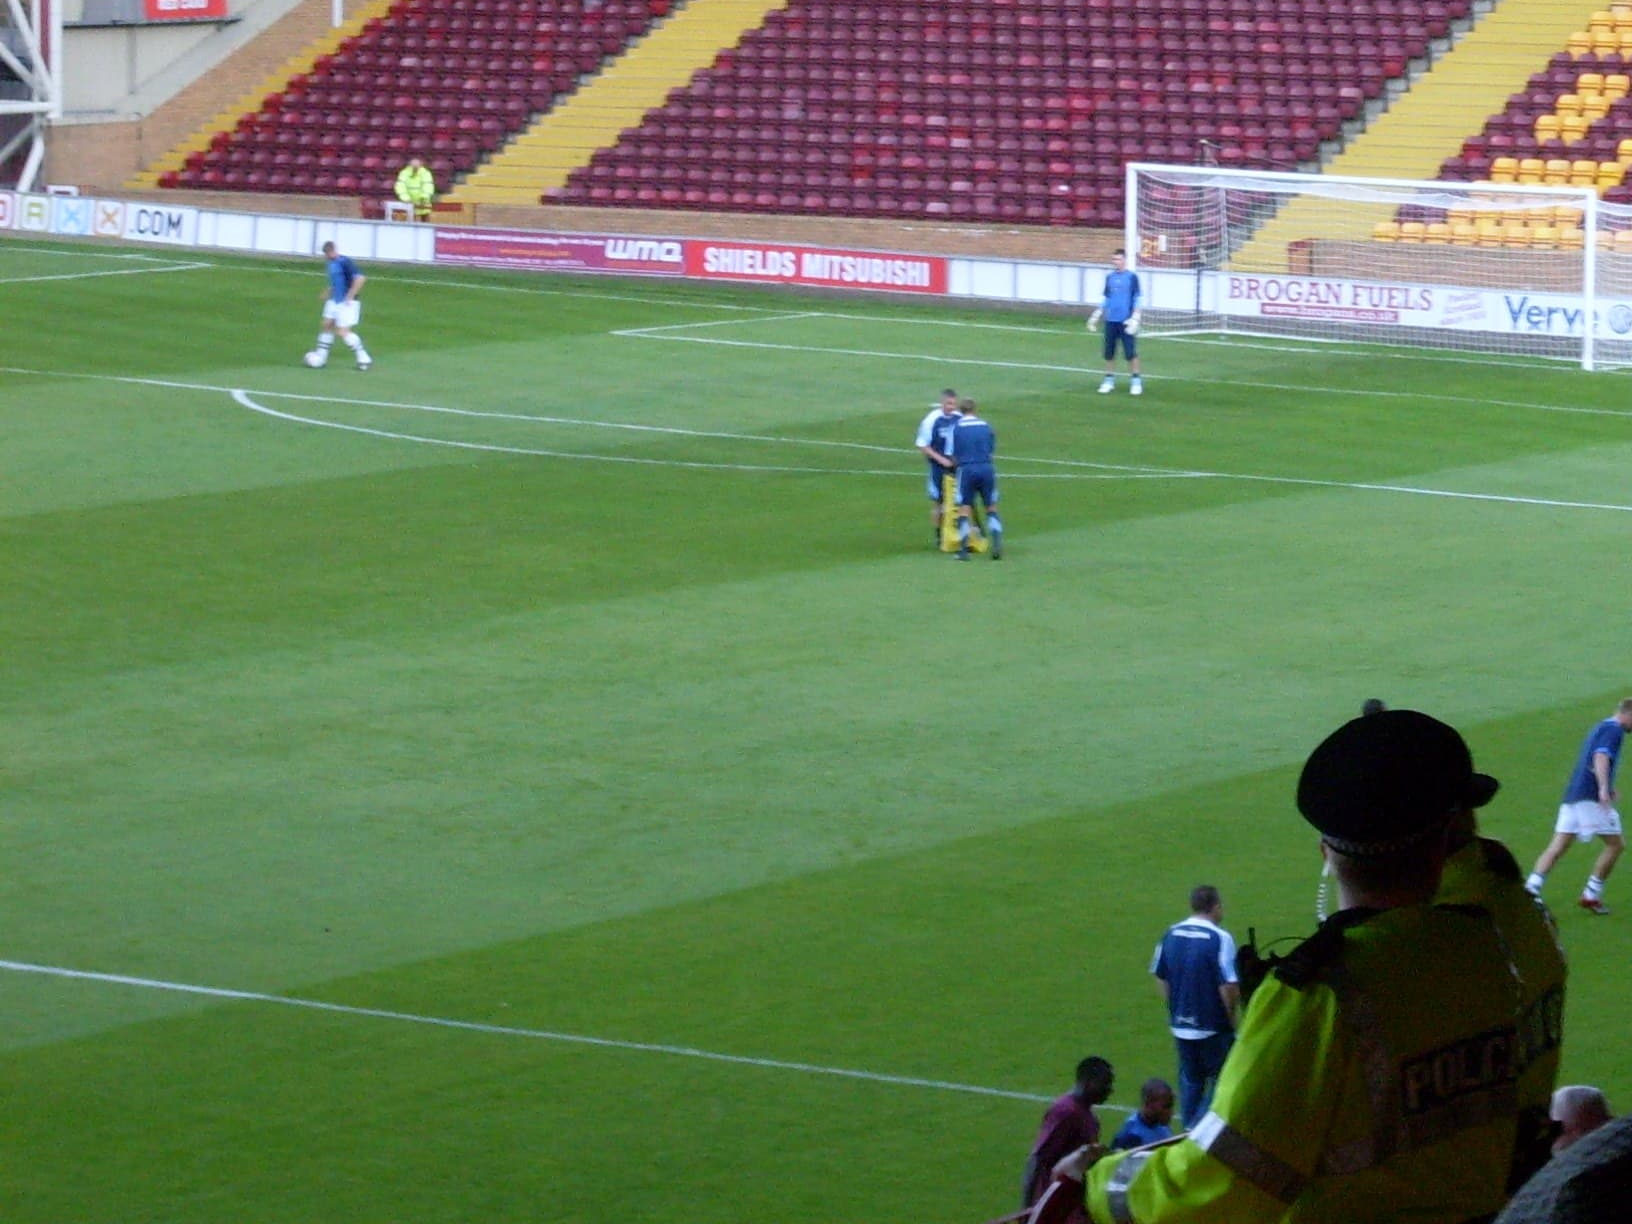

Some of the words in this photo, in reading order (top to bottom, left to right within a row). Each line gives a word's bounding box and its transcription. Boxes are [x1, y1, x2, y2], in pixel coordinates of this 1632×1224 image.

[703, 246, 797, 277] SHIELDS
[801, 252, 931, 287] MITSUBISHI
[1228, 276, 1344, 306] BROGAN
[1351, 283, 1434, 312] FUELS
